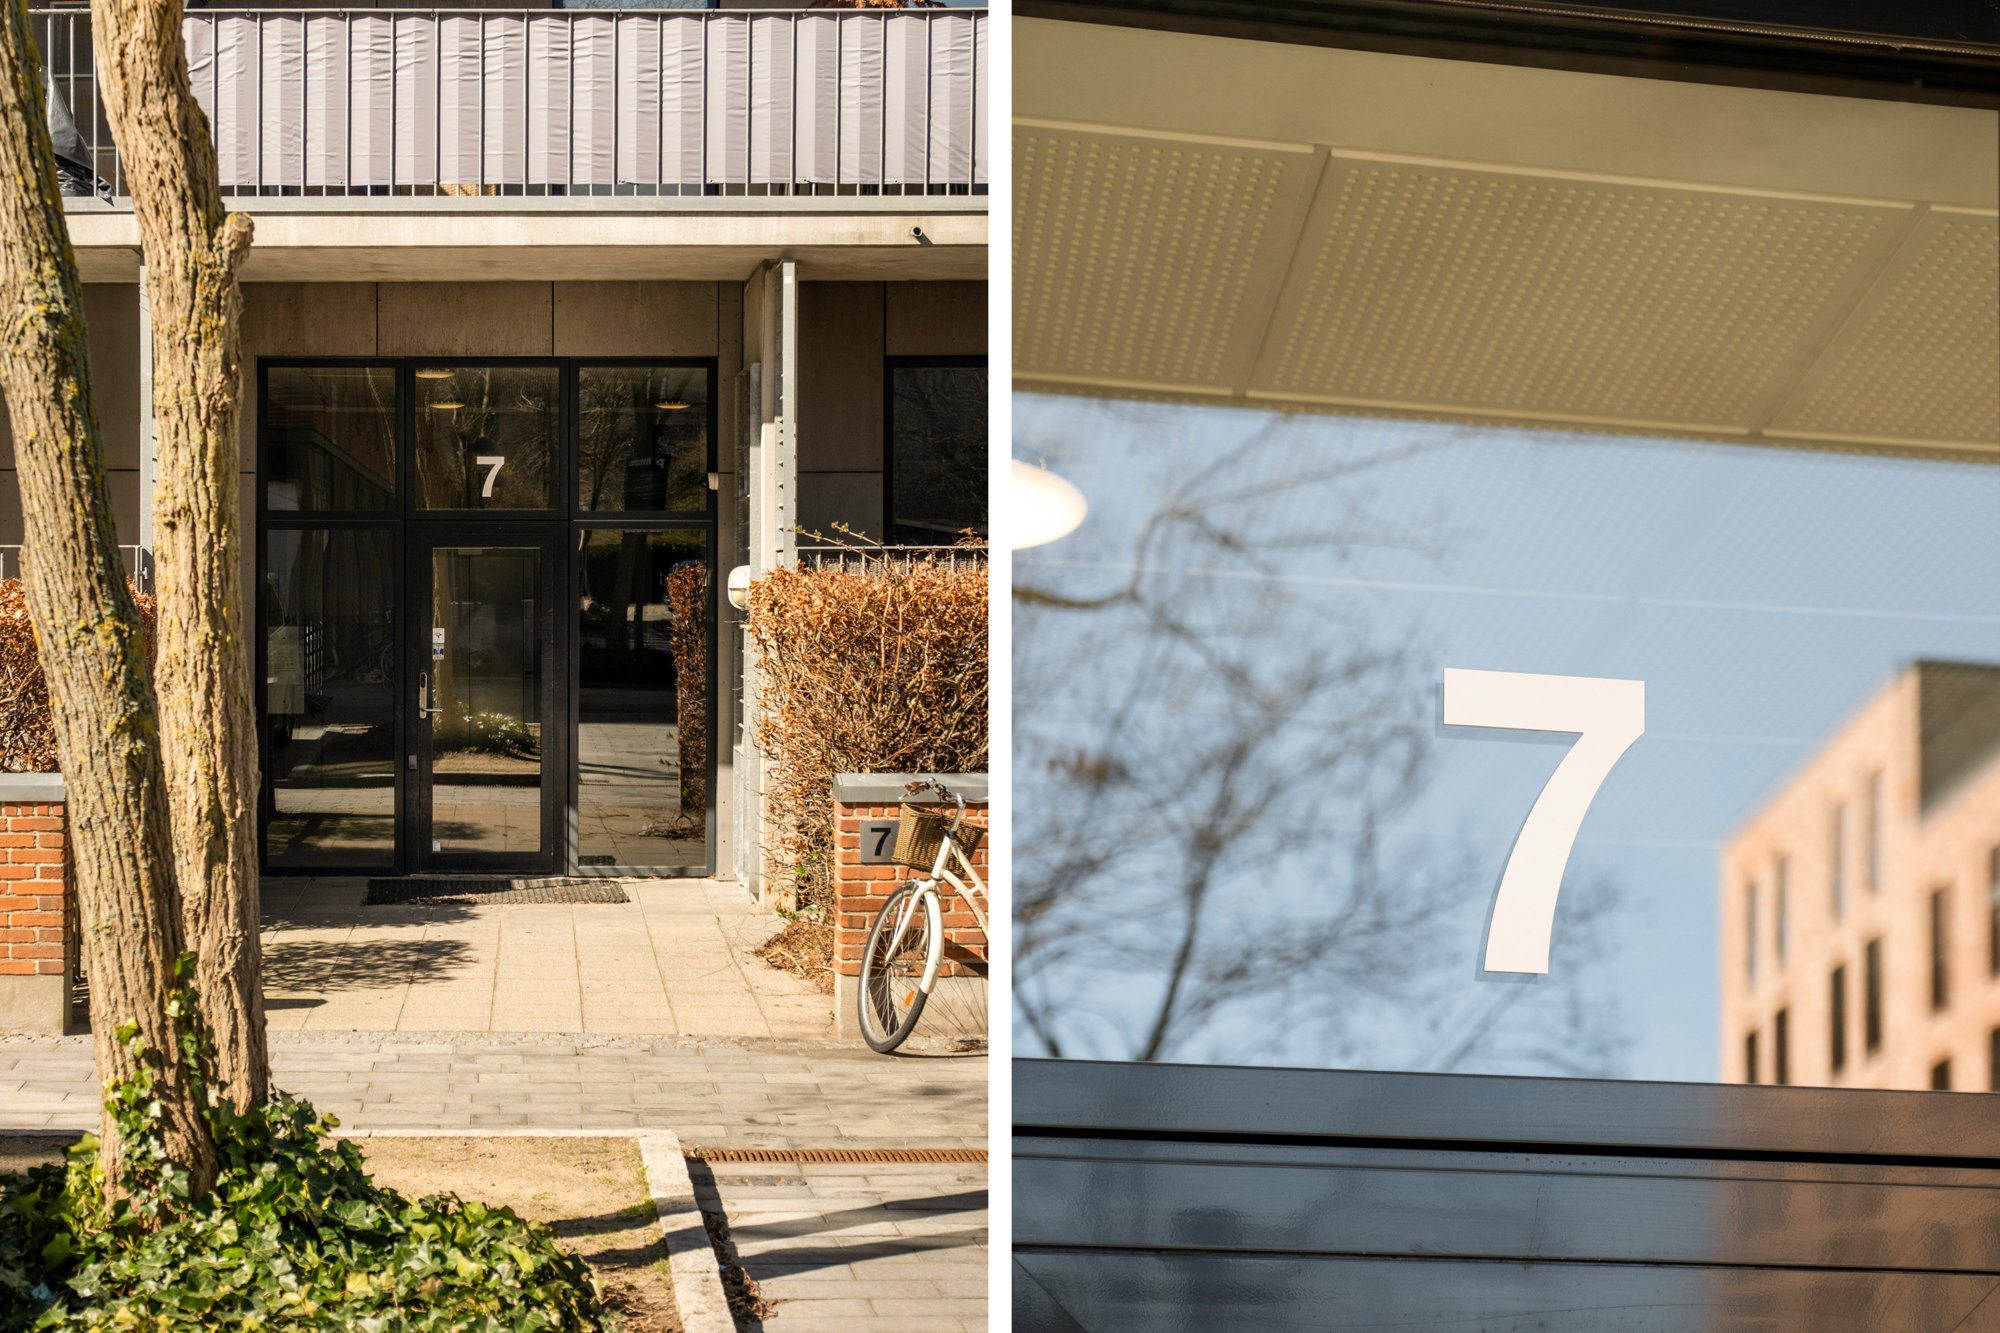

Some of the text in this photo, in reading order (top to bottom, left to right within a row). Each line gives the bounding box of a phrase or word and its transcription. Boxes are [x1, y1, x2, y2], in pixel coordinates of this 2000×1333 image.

[476, 456, 505, 498] 7
[1443, 667, 1646, 974] 7
[870, 827, 892, 857] 7
